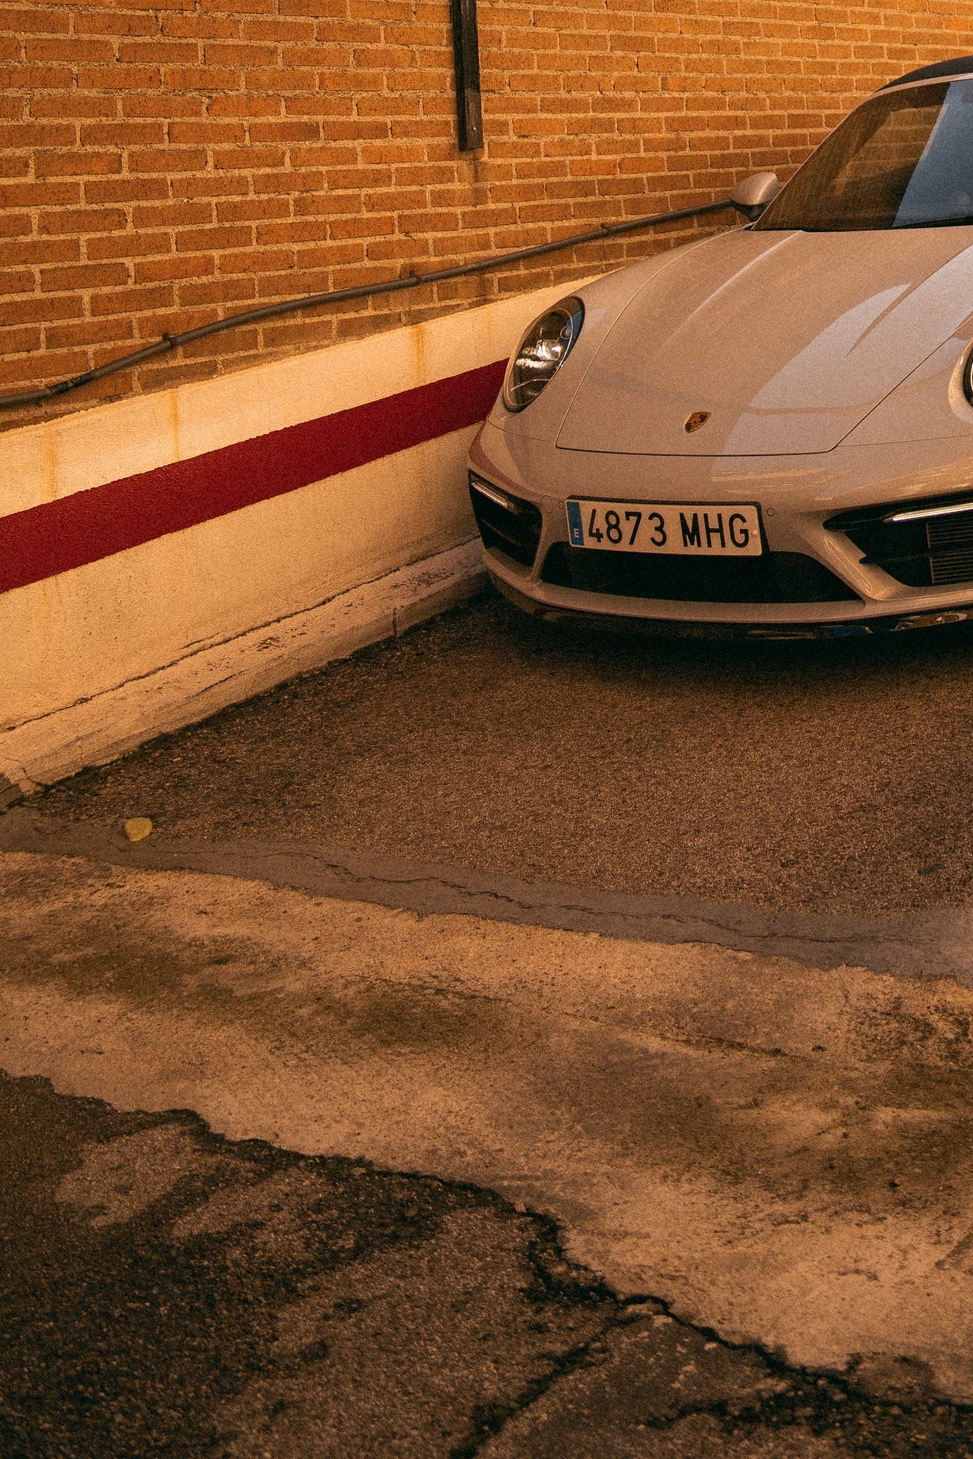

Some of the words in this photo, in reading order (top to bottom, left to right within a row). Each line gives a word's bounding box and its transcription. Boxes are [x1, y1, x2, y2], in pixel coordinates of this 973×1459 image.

[573, 528, 580, 538] E
[588, 508, 667, 547] 4873
[679, 512, 750, 549] MHG
